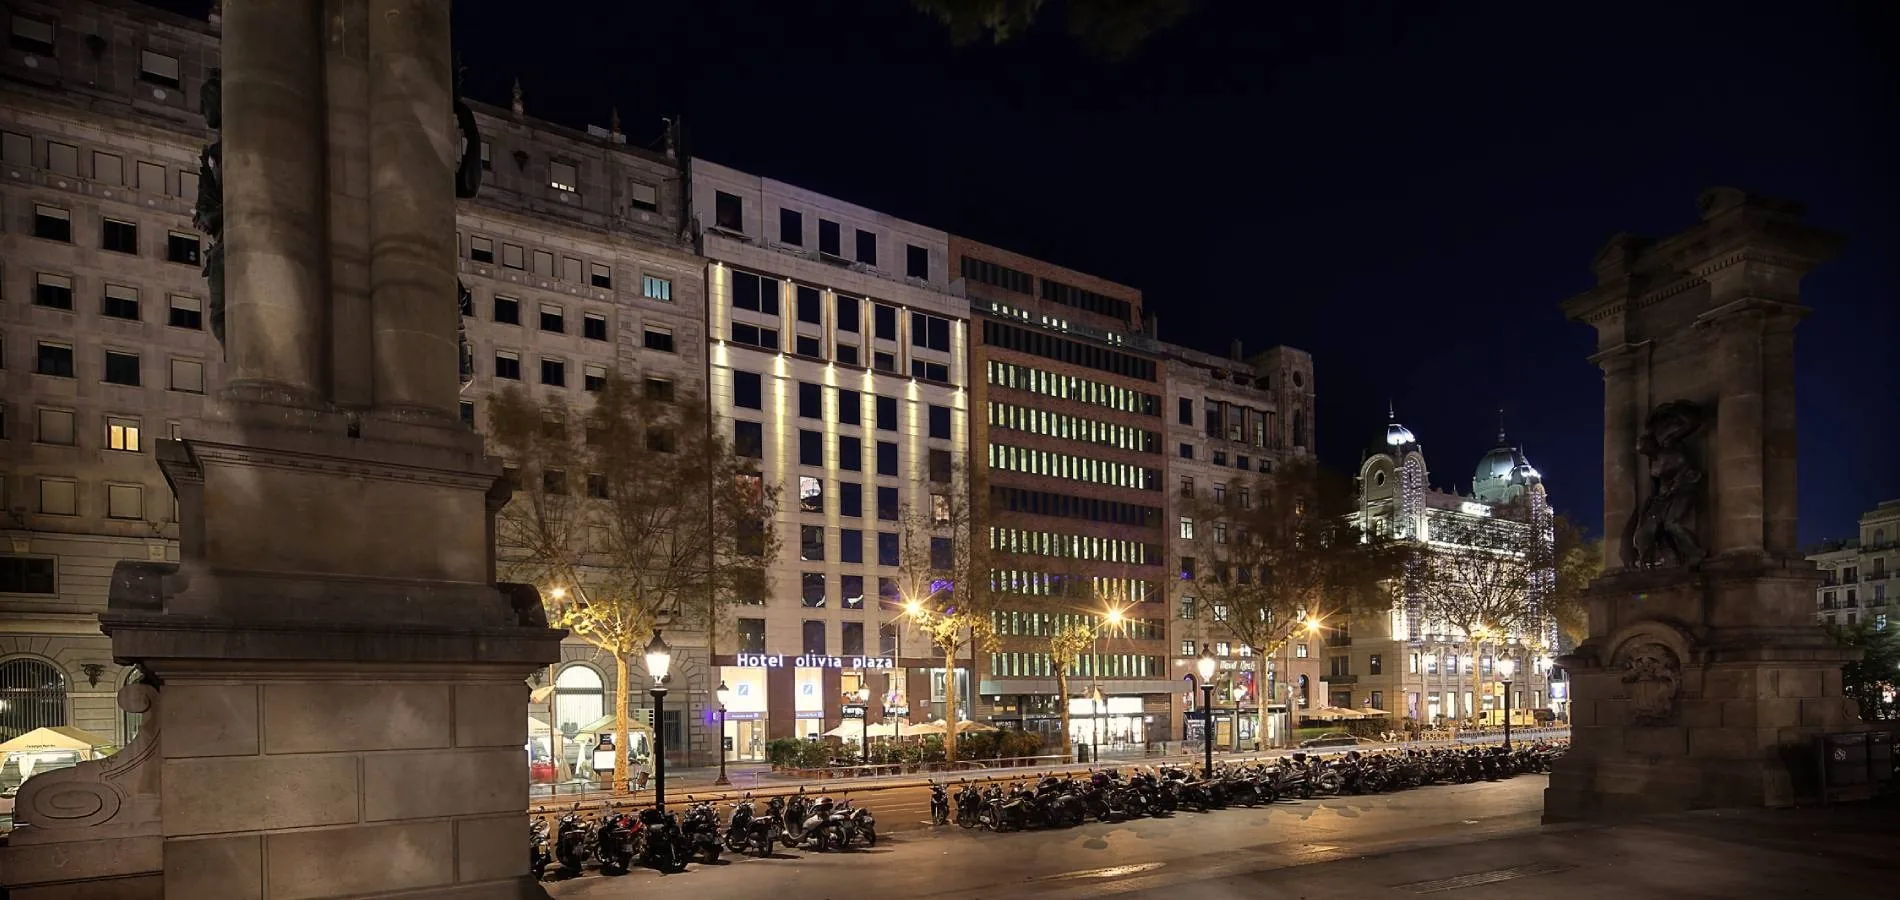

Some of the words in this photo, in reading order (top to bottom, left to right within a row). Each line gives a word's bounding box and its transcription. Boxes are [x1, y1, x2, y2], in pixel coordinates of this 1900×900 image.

[736, 653, 784, 667] Hotel
[796, 653, 842, 667] olivia
[852, 655, 893, 669] plaza
